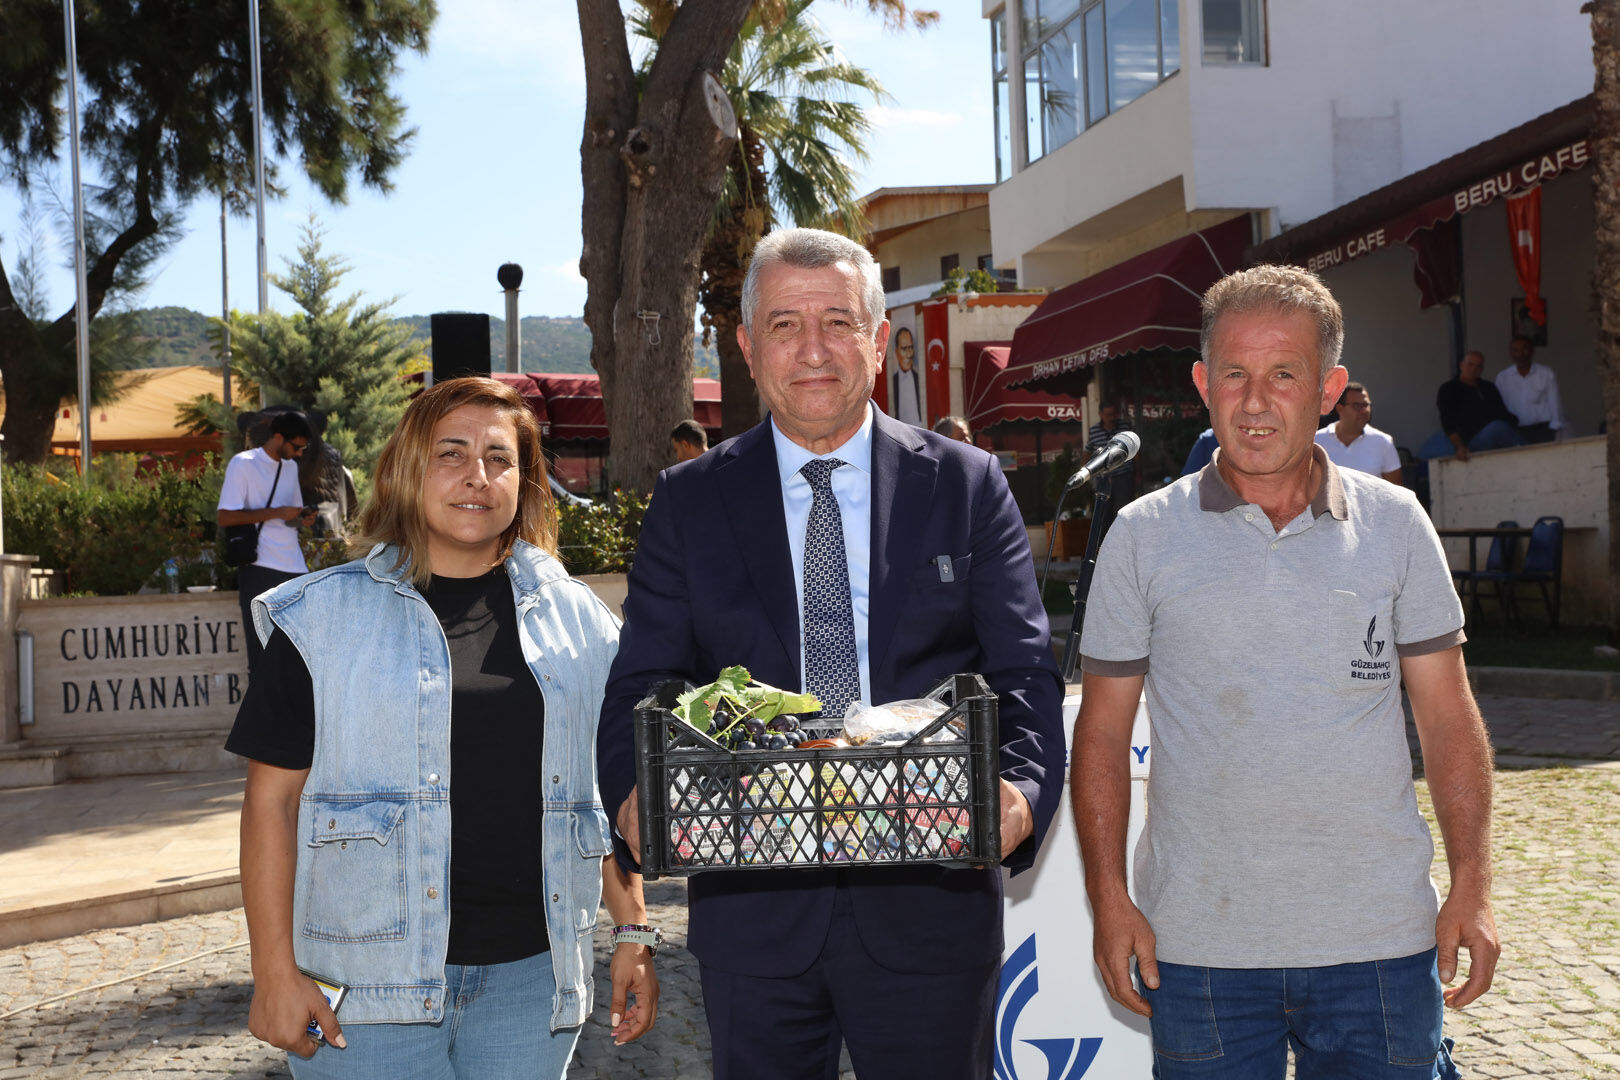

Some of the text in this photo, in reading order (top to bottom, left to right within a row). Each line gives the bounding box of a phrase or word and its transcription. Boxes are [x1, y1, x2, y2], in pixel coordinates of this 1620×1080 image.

[1454, 141, 1589, 212] BERU CAFE
[1307, 228, 1386, 272] BERU CAFE
[1032, 361, 1060, 377] ORHAN
[62, 674, 210, 714] DAYANAN
